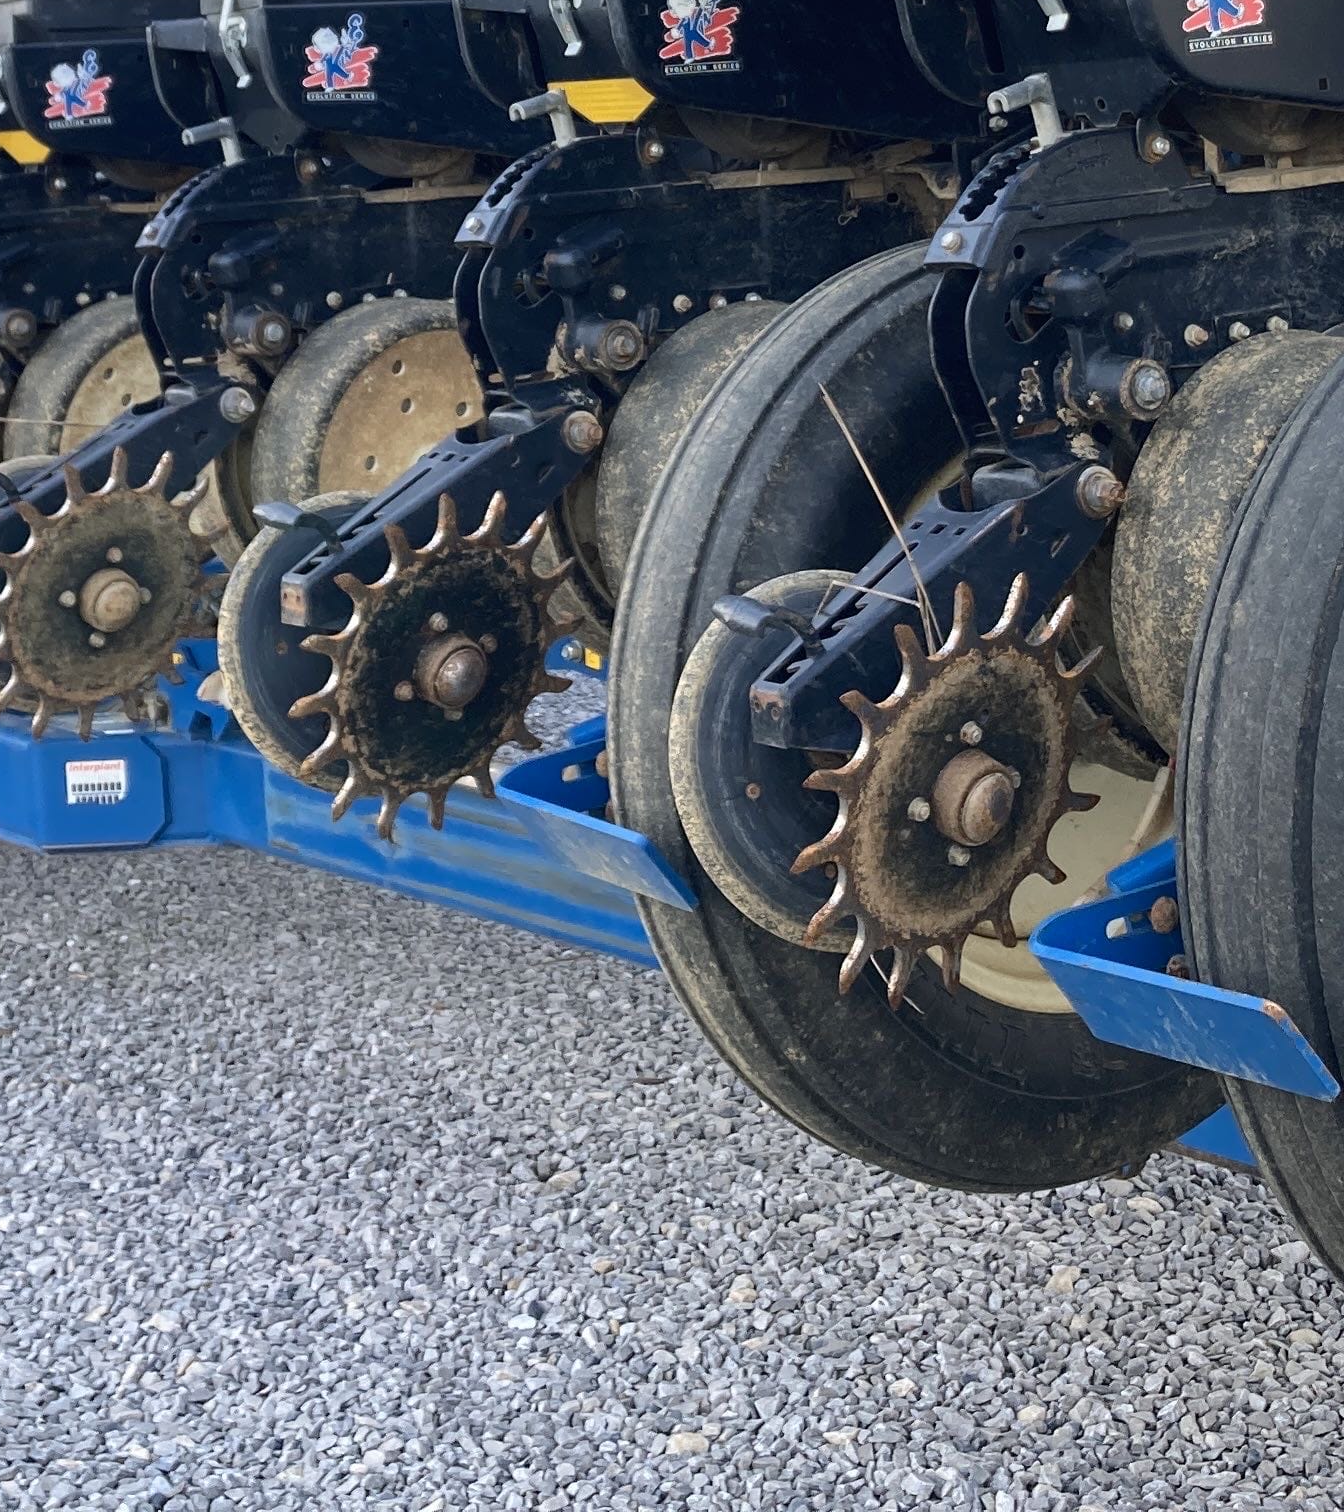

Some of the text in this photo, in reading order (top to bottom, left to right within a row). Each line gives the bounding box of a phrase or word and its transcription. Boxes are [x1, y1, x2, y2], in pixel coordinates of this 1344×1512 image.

[1189, 34, 1273, 51] EVOLUTION SERIES
[664, 64, 708, 74] EVOLUTION
